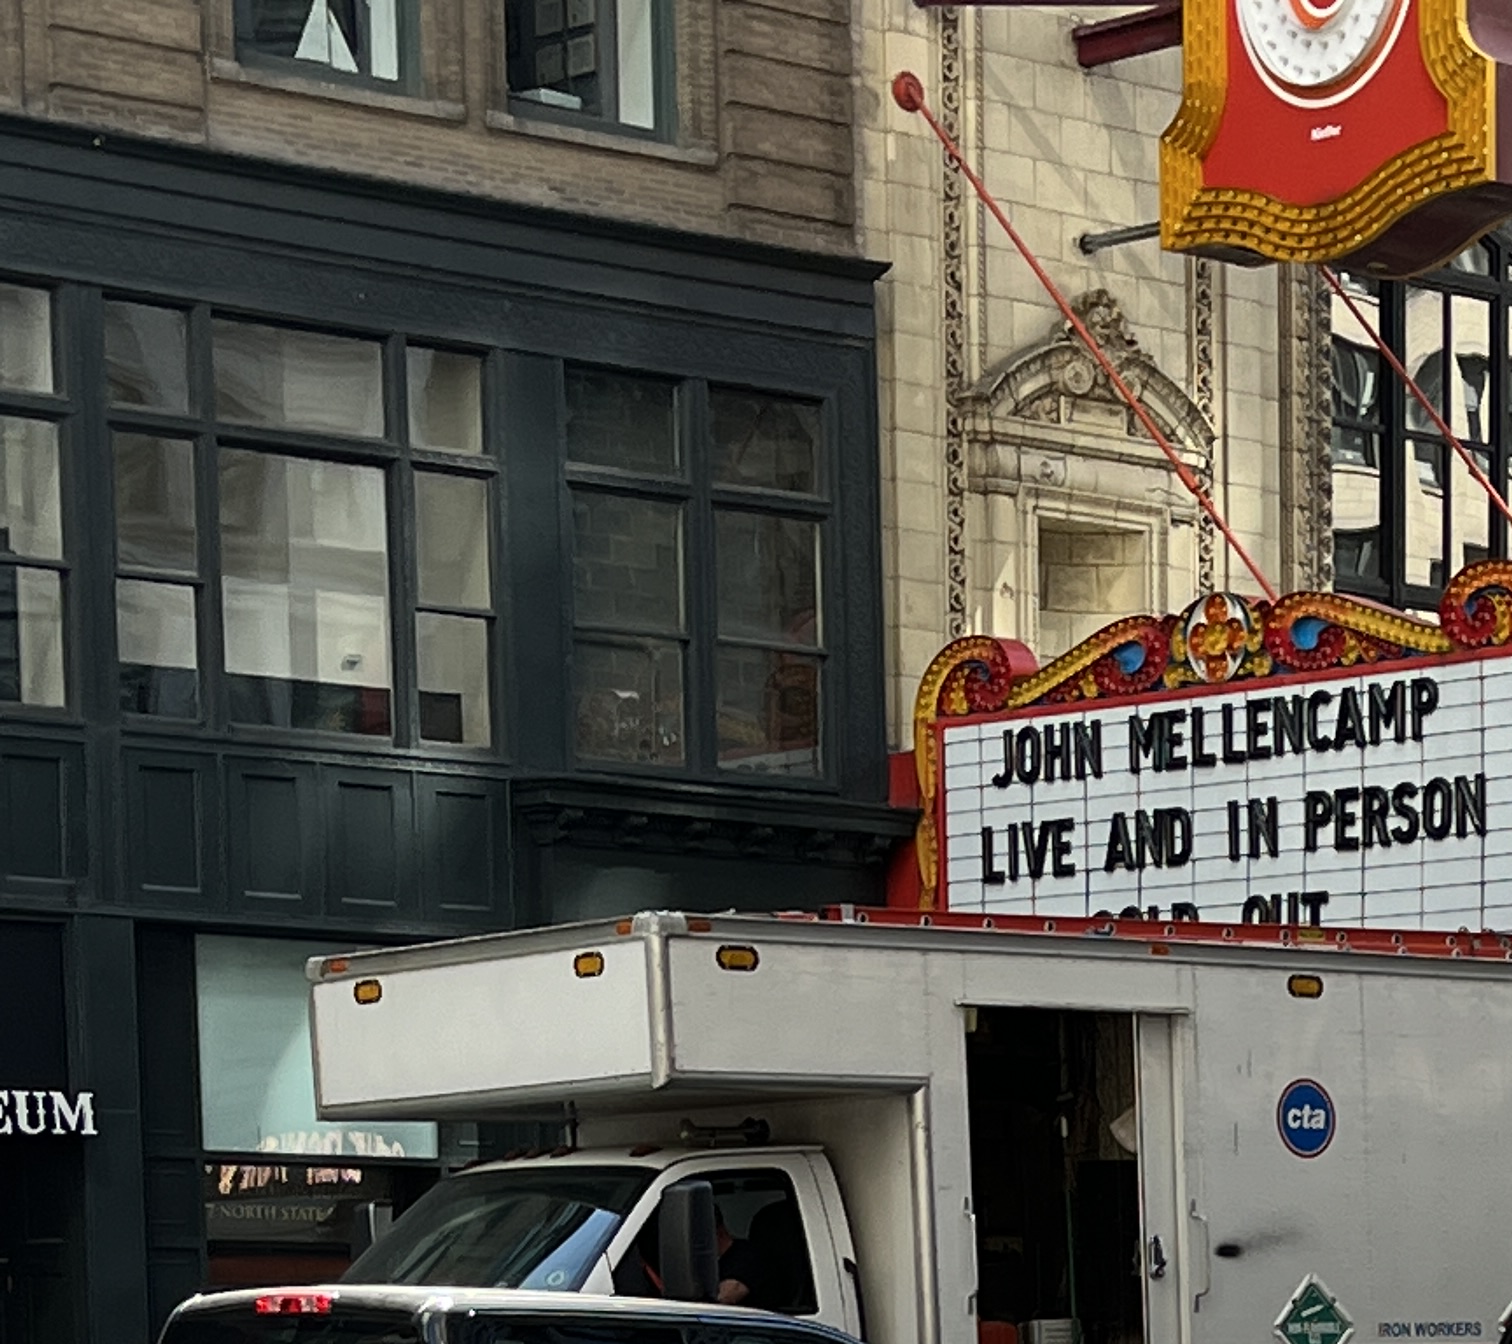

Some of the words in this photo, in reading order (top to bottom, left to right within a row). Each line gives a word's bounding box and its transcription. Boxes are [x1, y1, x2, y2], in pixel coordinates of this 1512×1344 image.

[992, 718, 1102, 789] JOHN
[1128, 676, 1438, 775] MELLENCAMP
[981, 816, 1075, 884] LIVE
[1104, 806, 1192, 873] AND
[1226, 796, 1279, 861] IN
[1303, 772, 1487, 853] PERSON
[1287, 1103, 1327, 1130] cta
[220, 1204, 276, 1219] NORTH
[1378, 1322, 1411, 1337] IRON
[1414, 1321, 1482, 1337] WORKERS
